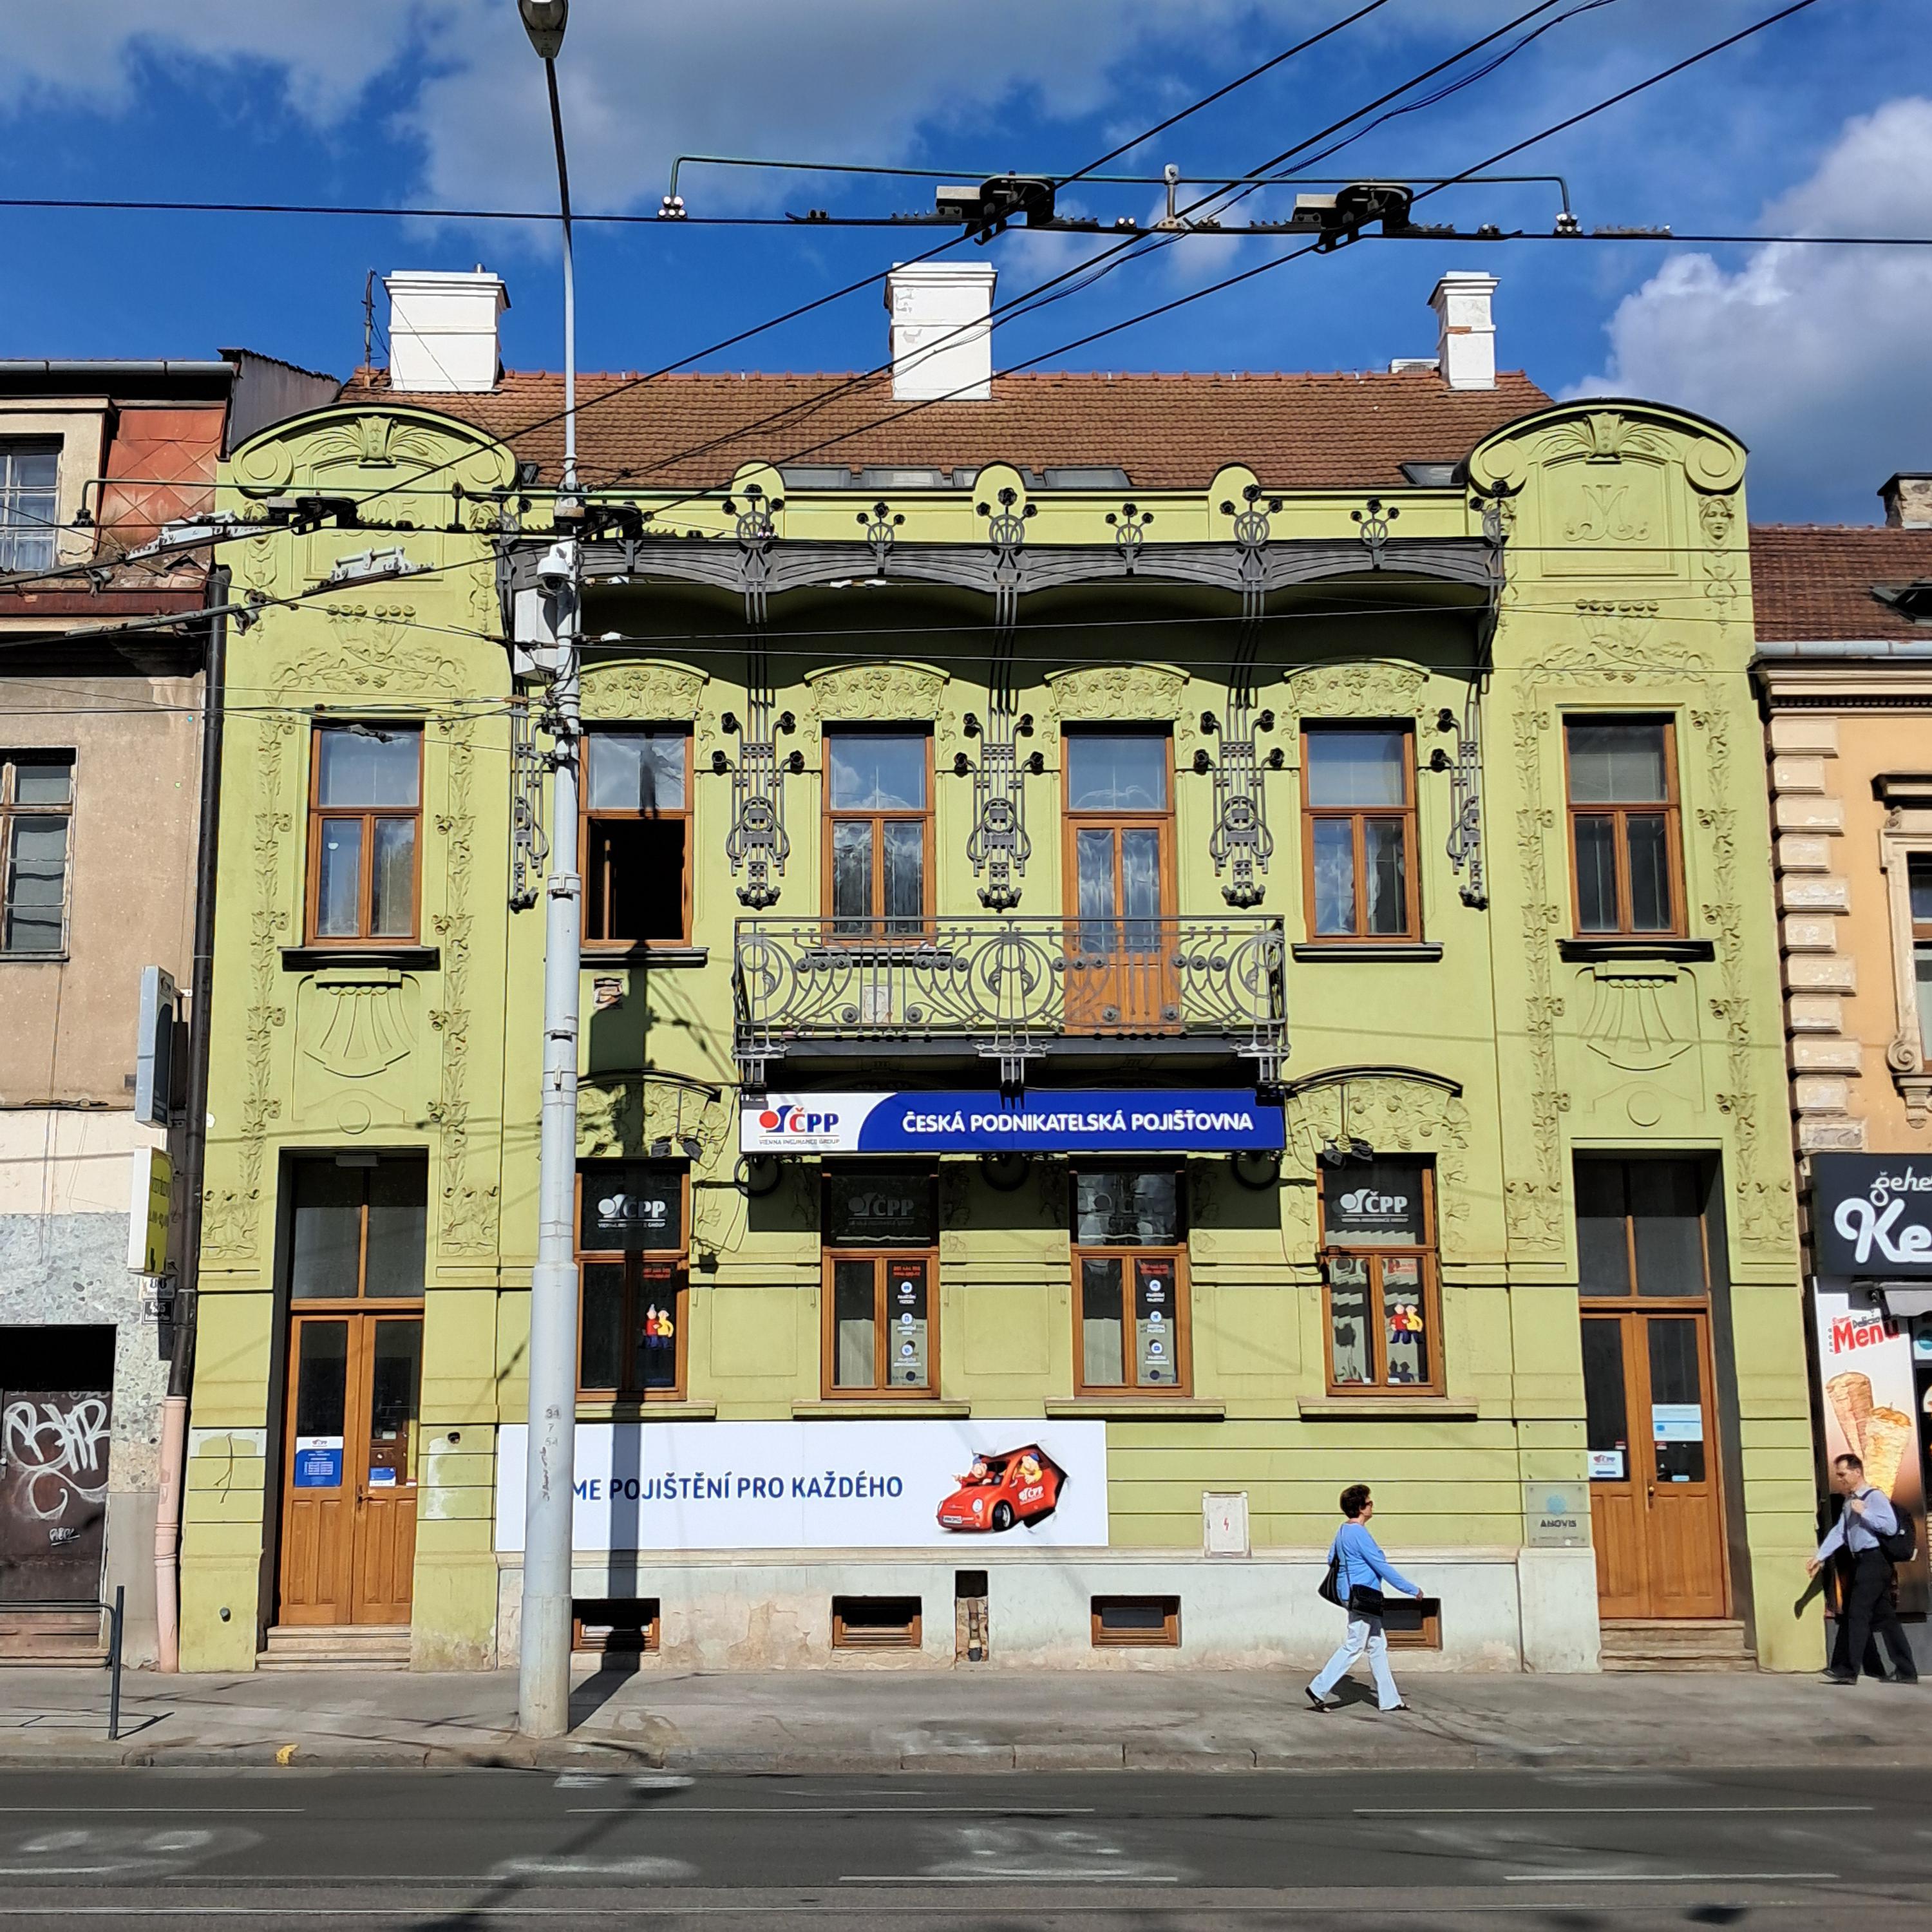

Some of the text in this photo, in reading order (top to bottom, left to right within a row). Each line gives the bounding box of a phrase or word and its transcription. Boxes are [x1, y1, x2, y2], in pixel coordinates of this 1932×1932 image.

[790, 1107, 839, 1133] ČPP
[902, 1109, 1254, 1132] ČESKÁ PODNIKATELSKÁ POJIŠŤOVNA
[873, 1194, 914, 1217] ČPP
[1365, 1191, 1408, 1213] ČPP
[1834, 1198, 1932, 1264] Ke
[1833, 1319, 1900, 1354] Menu
[573, 1470, 902, 1500] ME POJIŠTĚNÍ PRO KAŽDÉHO
